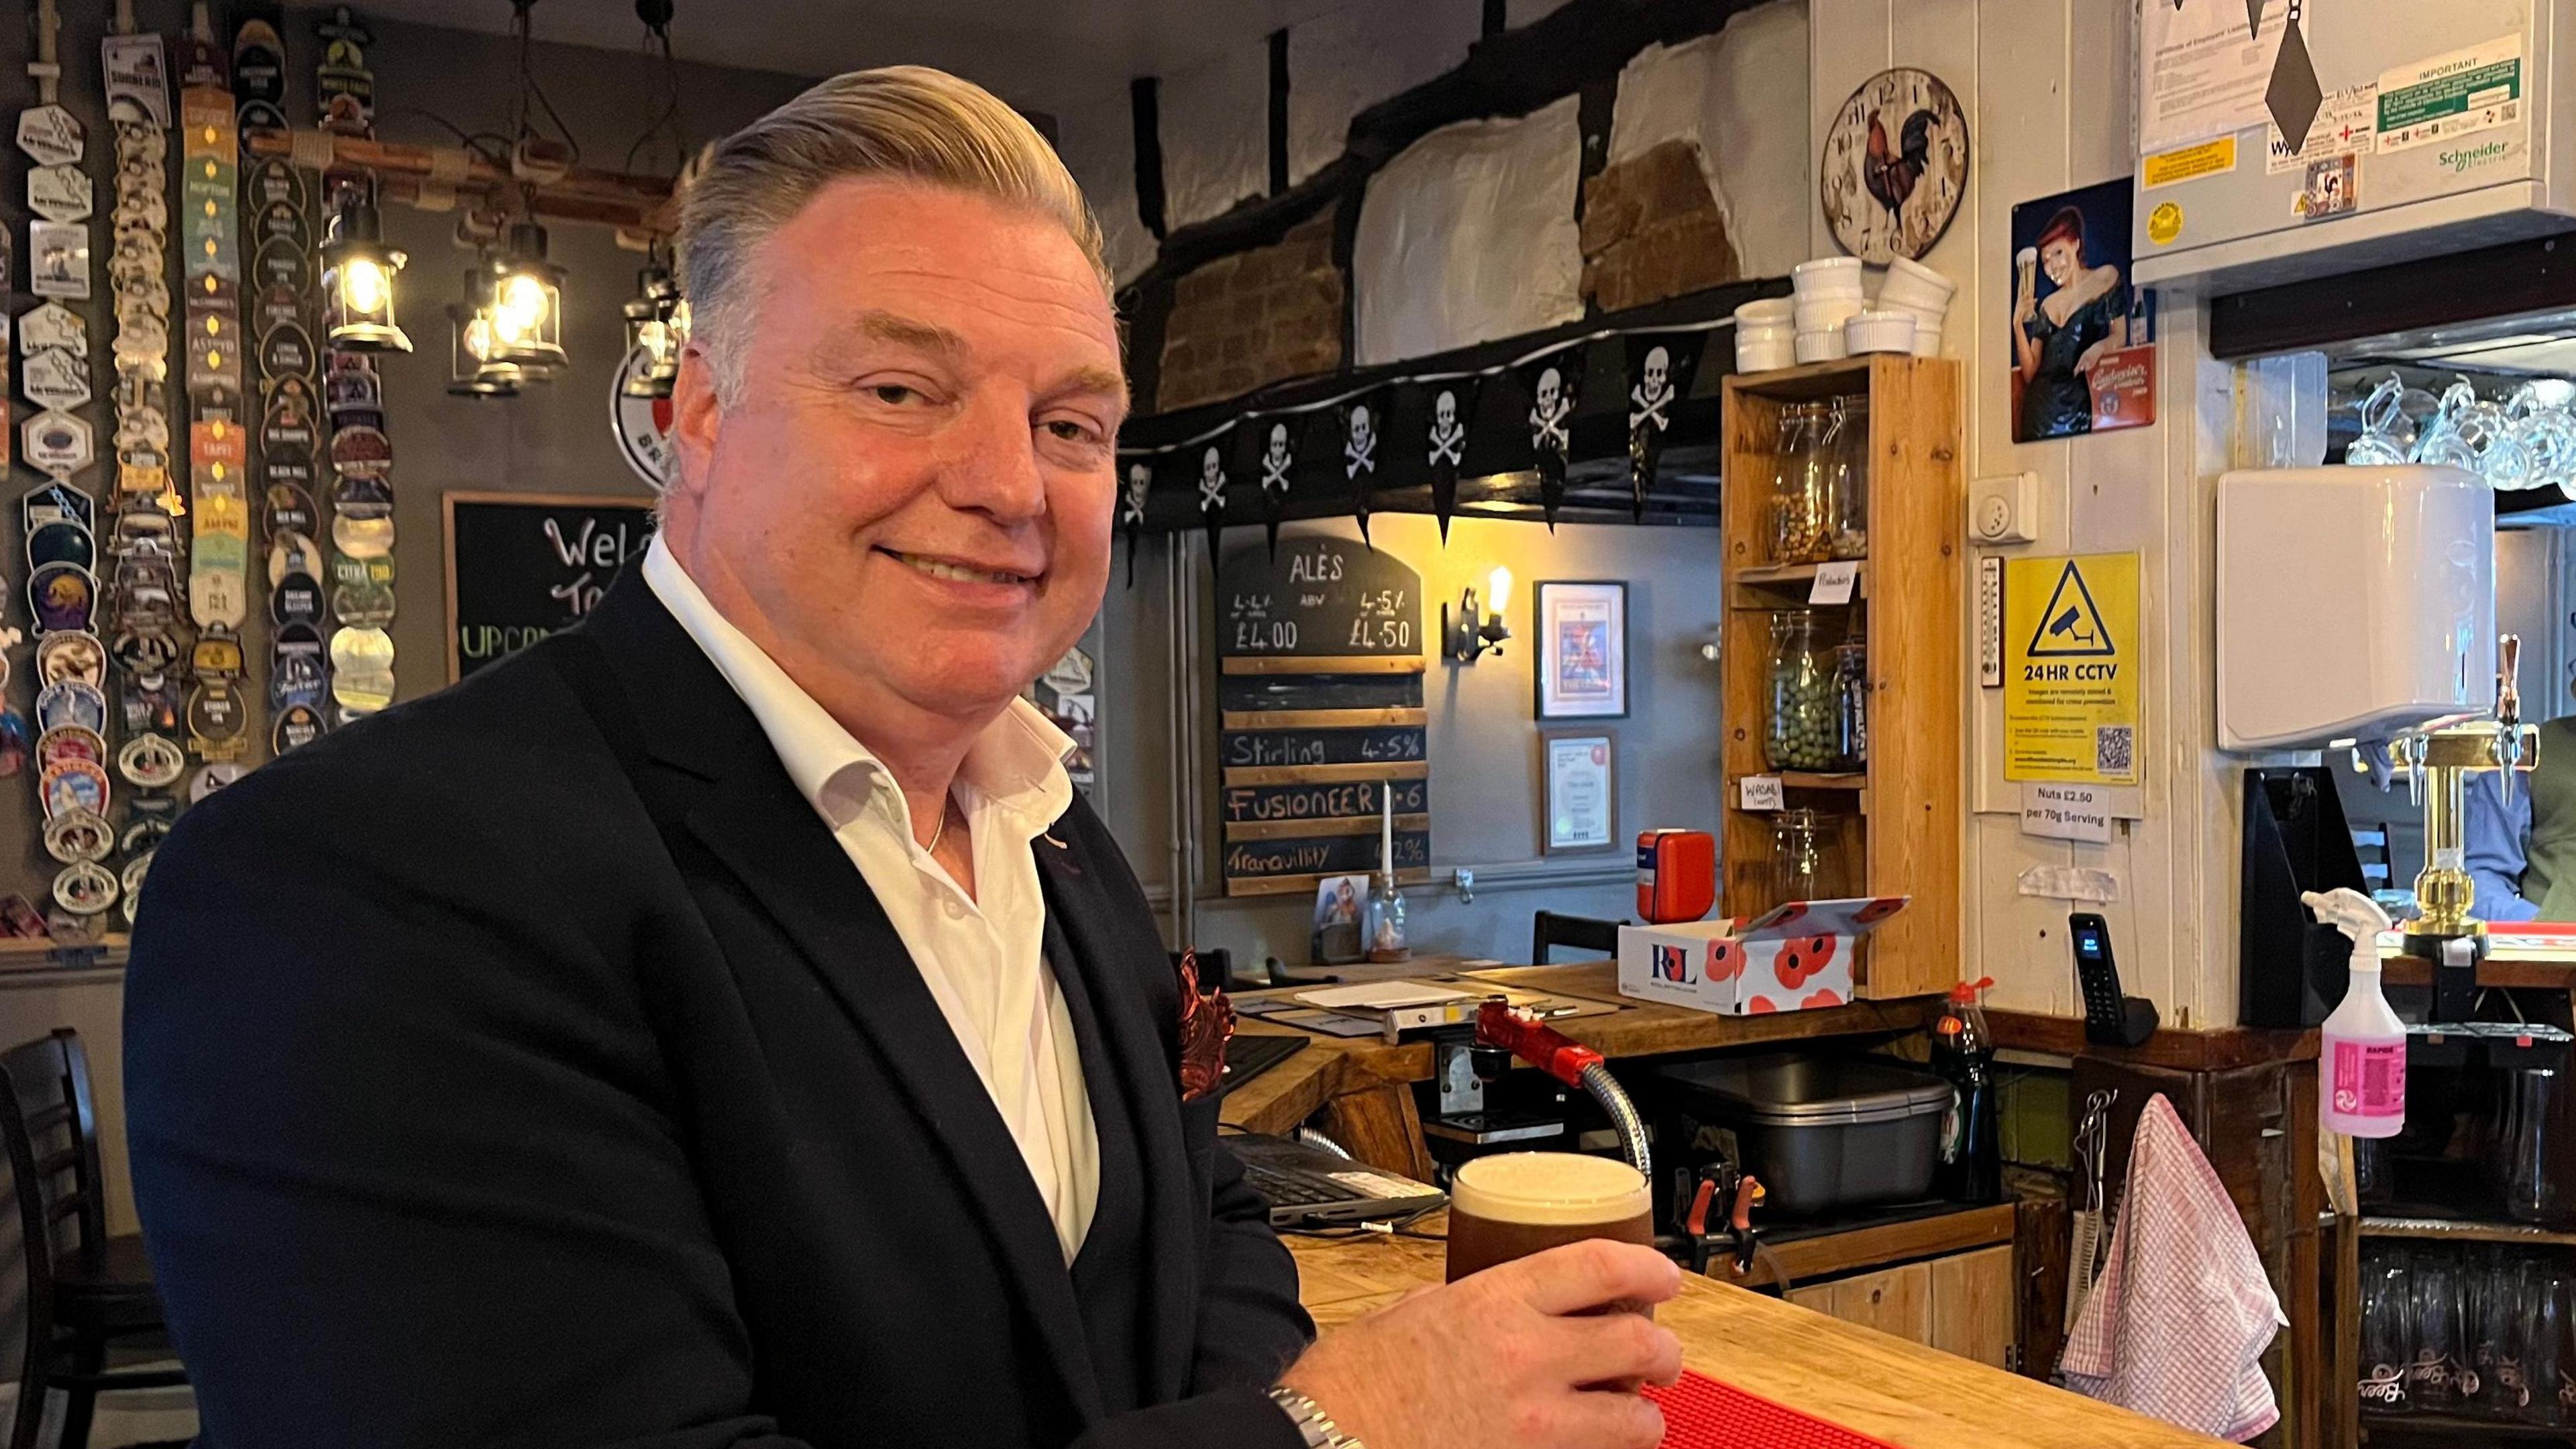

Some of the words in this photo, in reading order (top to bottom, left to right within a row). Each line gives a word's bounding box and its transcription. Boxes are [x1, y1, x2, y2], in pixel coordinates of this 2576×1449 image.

[2419, 58, 2478, 80] IMPORTANT
[2439, 141, 2508, 172] Schneider
[2075, 663, 2118, 681] CCTV
[1230, 735, 1326, 766] Stirling
[2038, 788, 2061, 800] Nuts
[2027, 808, 2042, 819] per
[2045, 809, 2062, 823] 70g
[2064, 811, 2104, 828] Serving
